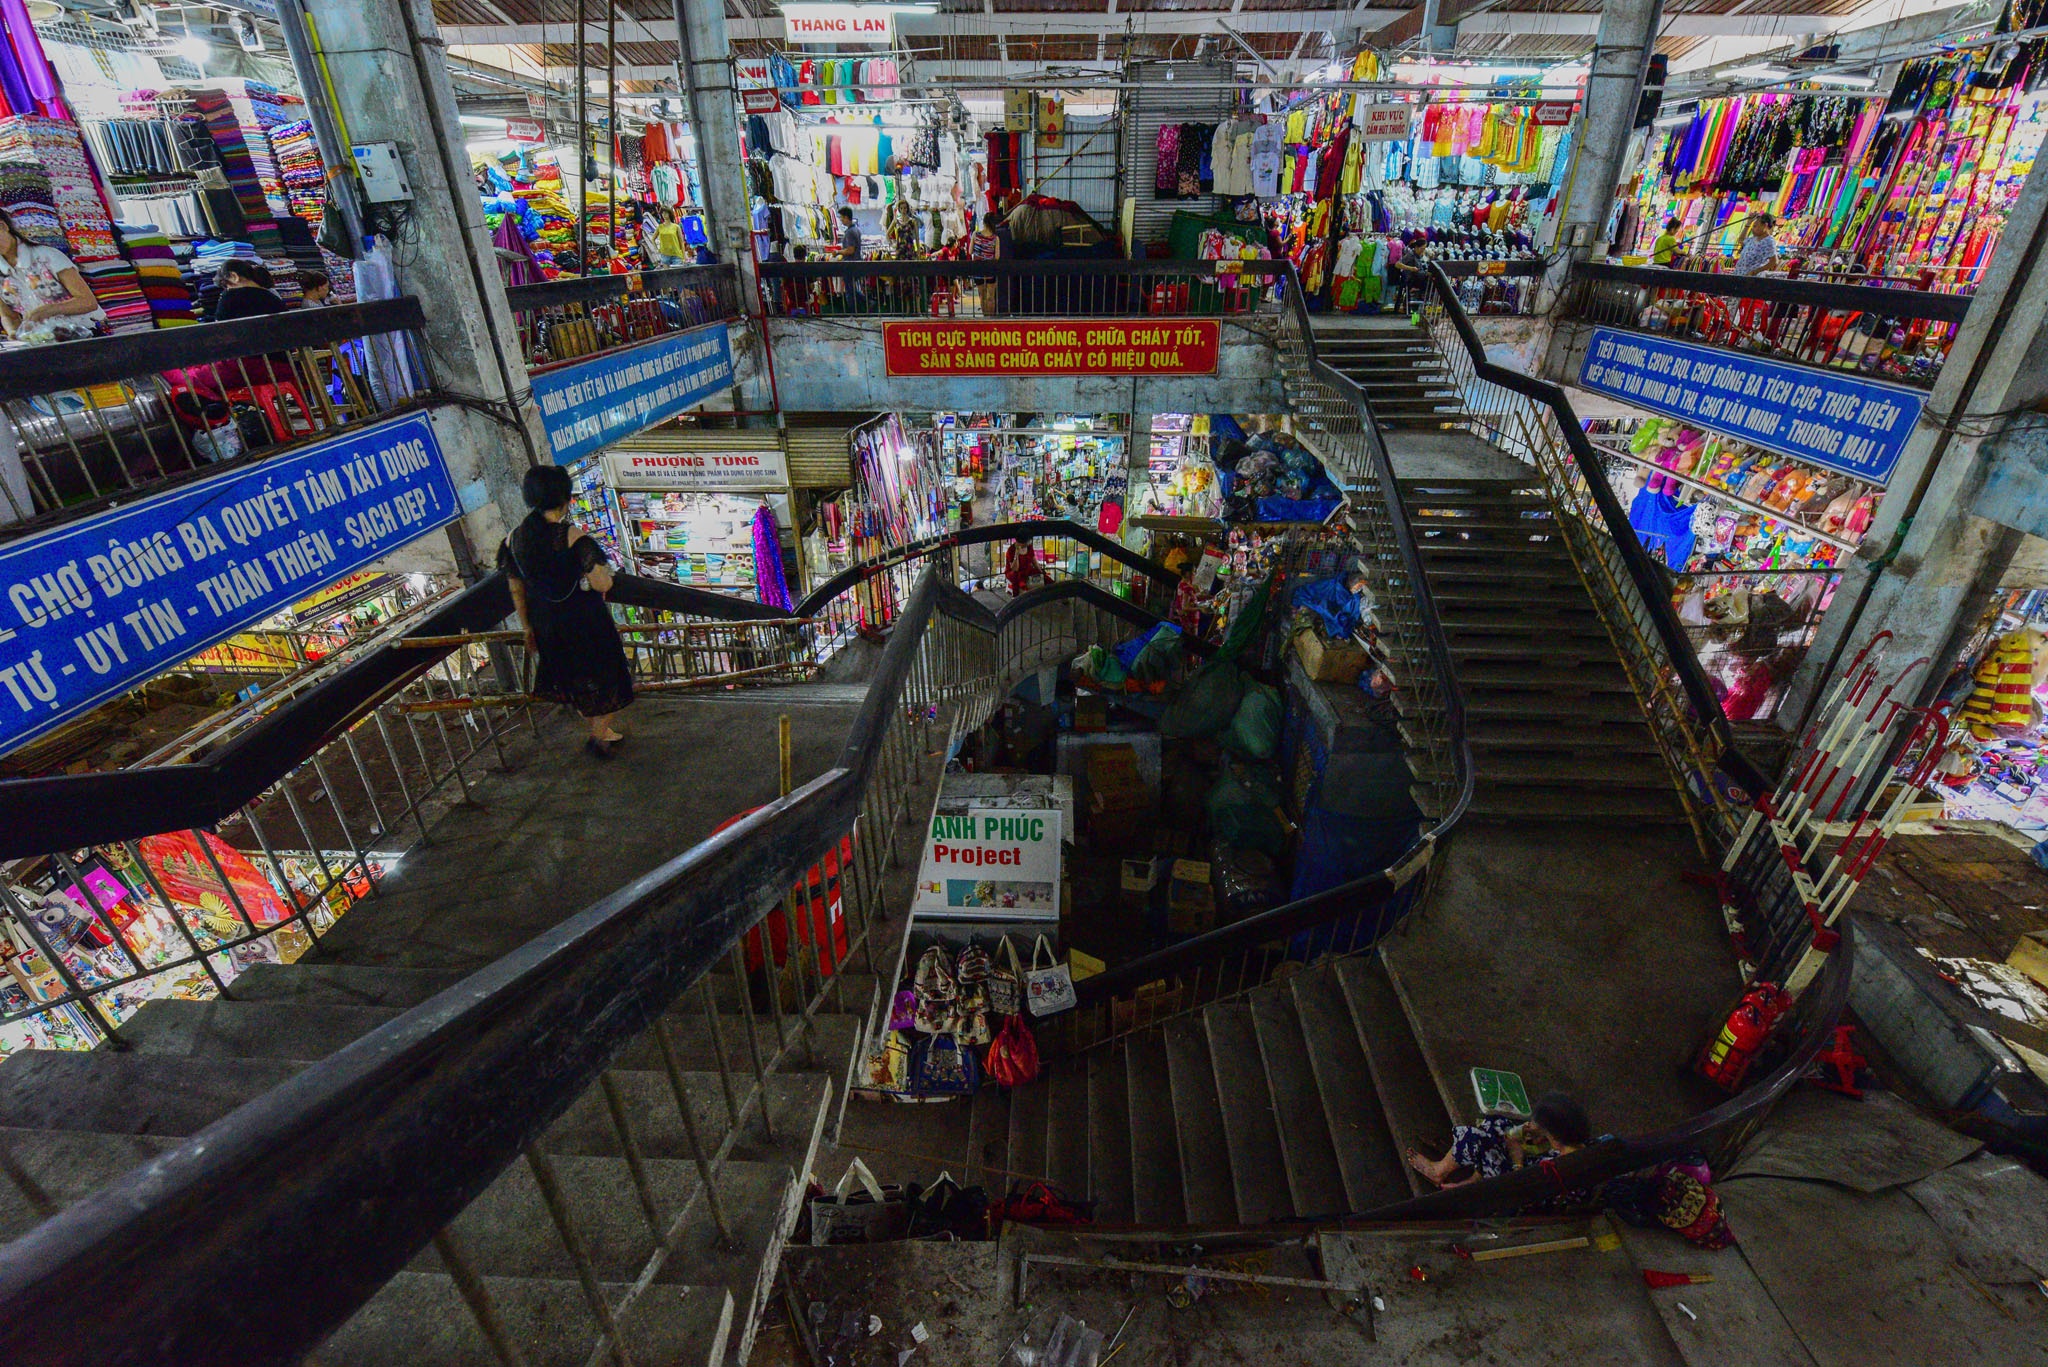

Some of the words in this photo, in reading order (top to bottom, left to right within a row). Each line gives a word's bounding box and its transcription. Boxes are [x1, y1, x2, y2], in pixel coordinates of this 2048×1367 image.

[853, 18, 885, 32] LAN
[1372, 111, 1387, 121] KHU
[1389, 109, 1404, 122] VỰC
[899, 328, 932, 347] TÍCH
[936, 331, 966, 350] CỰC
[970, 329, 1021, 347] PHÒNG
[1026, 325, 1081, 348] CHỐNG,
[1086, 326, 1126, 347] CHỮA
[1131, 327, 1172, 346] CHÁY
[1174, 325, 1205, 348] TỐT,
[920, 347, 950, 369] SẴN
[955, 349, 995, 369] SÀNG
[1000, 349, 1039, 368] CHỮA
[1044, 349, 1082, 368] CHÁY
[1087, 349, 1106, 368] CÓ
[1111, 349, 1145, 371] HIỆU
[1150, 346, 1184, 367] QUẢ.
[581, 373, 596, 402] YẾT
[1596, 338, 1615, 361] TIỂU
[1613, 341, 1647, 371] THƯƠNG,
[1647, 351, 1672, 376] CBVC
[1670, 357, 1690, 380] BQL
[1691, 362, 1715, 389] CHỢ
[1713, 365, 1744, 394] ĐÔNG
[1741, 373, 1763, 396] BA
[1766, 373, 1793, 403] TÍCH
[1795, 382, 1823, 414] CỰC
[1820, 389, 1860, 425] THỰC
[1856, 399, 1901, 436] HIỆN
[1586, 360, 1603, 382] NẾP
[1602, 365, 1625, 388] SỐNG
[1623, 372, 1642, 393] VĂN
[1641, 378, 1668, 401] MINH
[1665, 384, 1684, 407] ĐÔ
[1680, 388, 1698, 416] THỊ,
[1698, 394, 1725, 422] CHỢ
[1721, 400, 1746, 427] VĂN
[1742, 406, 1782, 436] MINH
[1788, 418, 1844, 454] THƯƠNG
[1839, 434, 1876, 470] MẠI
[632, 456, 705, 468] PHƯỢNG
[712, 454, 759, 466] TÙNG
[8, 559, 96, 619] CHỢ
[86, 531, 184, 598] ĐÔNG
[177, 516, 226, 563] BA
[221, 476, 301, 545] QUYẾT
[294, 466, 347, 514] TÂM
[341, 451, 388, 498] XÂY
[380, 438, 431, 486] DỰNG
[0, 649, 60, 712] TỰ
[73, 622, 129, 675] UY
[124, 597, 188, 654] TÍN
[196, 559, 274, 618] THÂN
[267, 527, 337, 577] THIỆN
[346, 495, 399, 550] SẠCH
[396, 490, 428, 529] ĐẸP
[432, 481, 442, 512] !
[984, 812, 1044, 842] PHÚC
[933, 844, 1021, 867] Project
